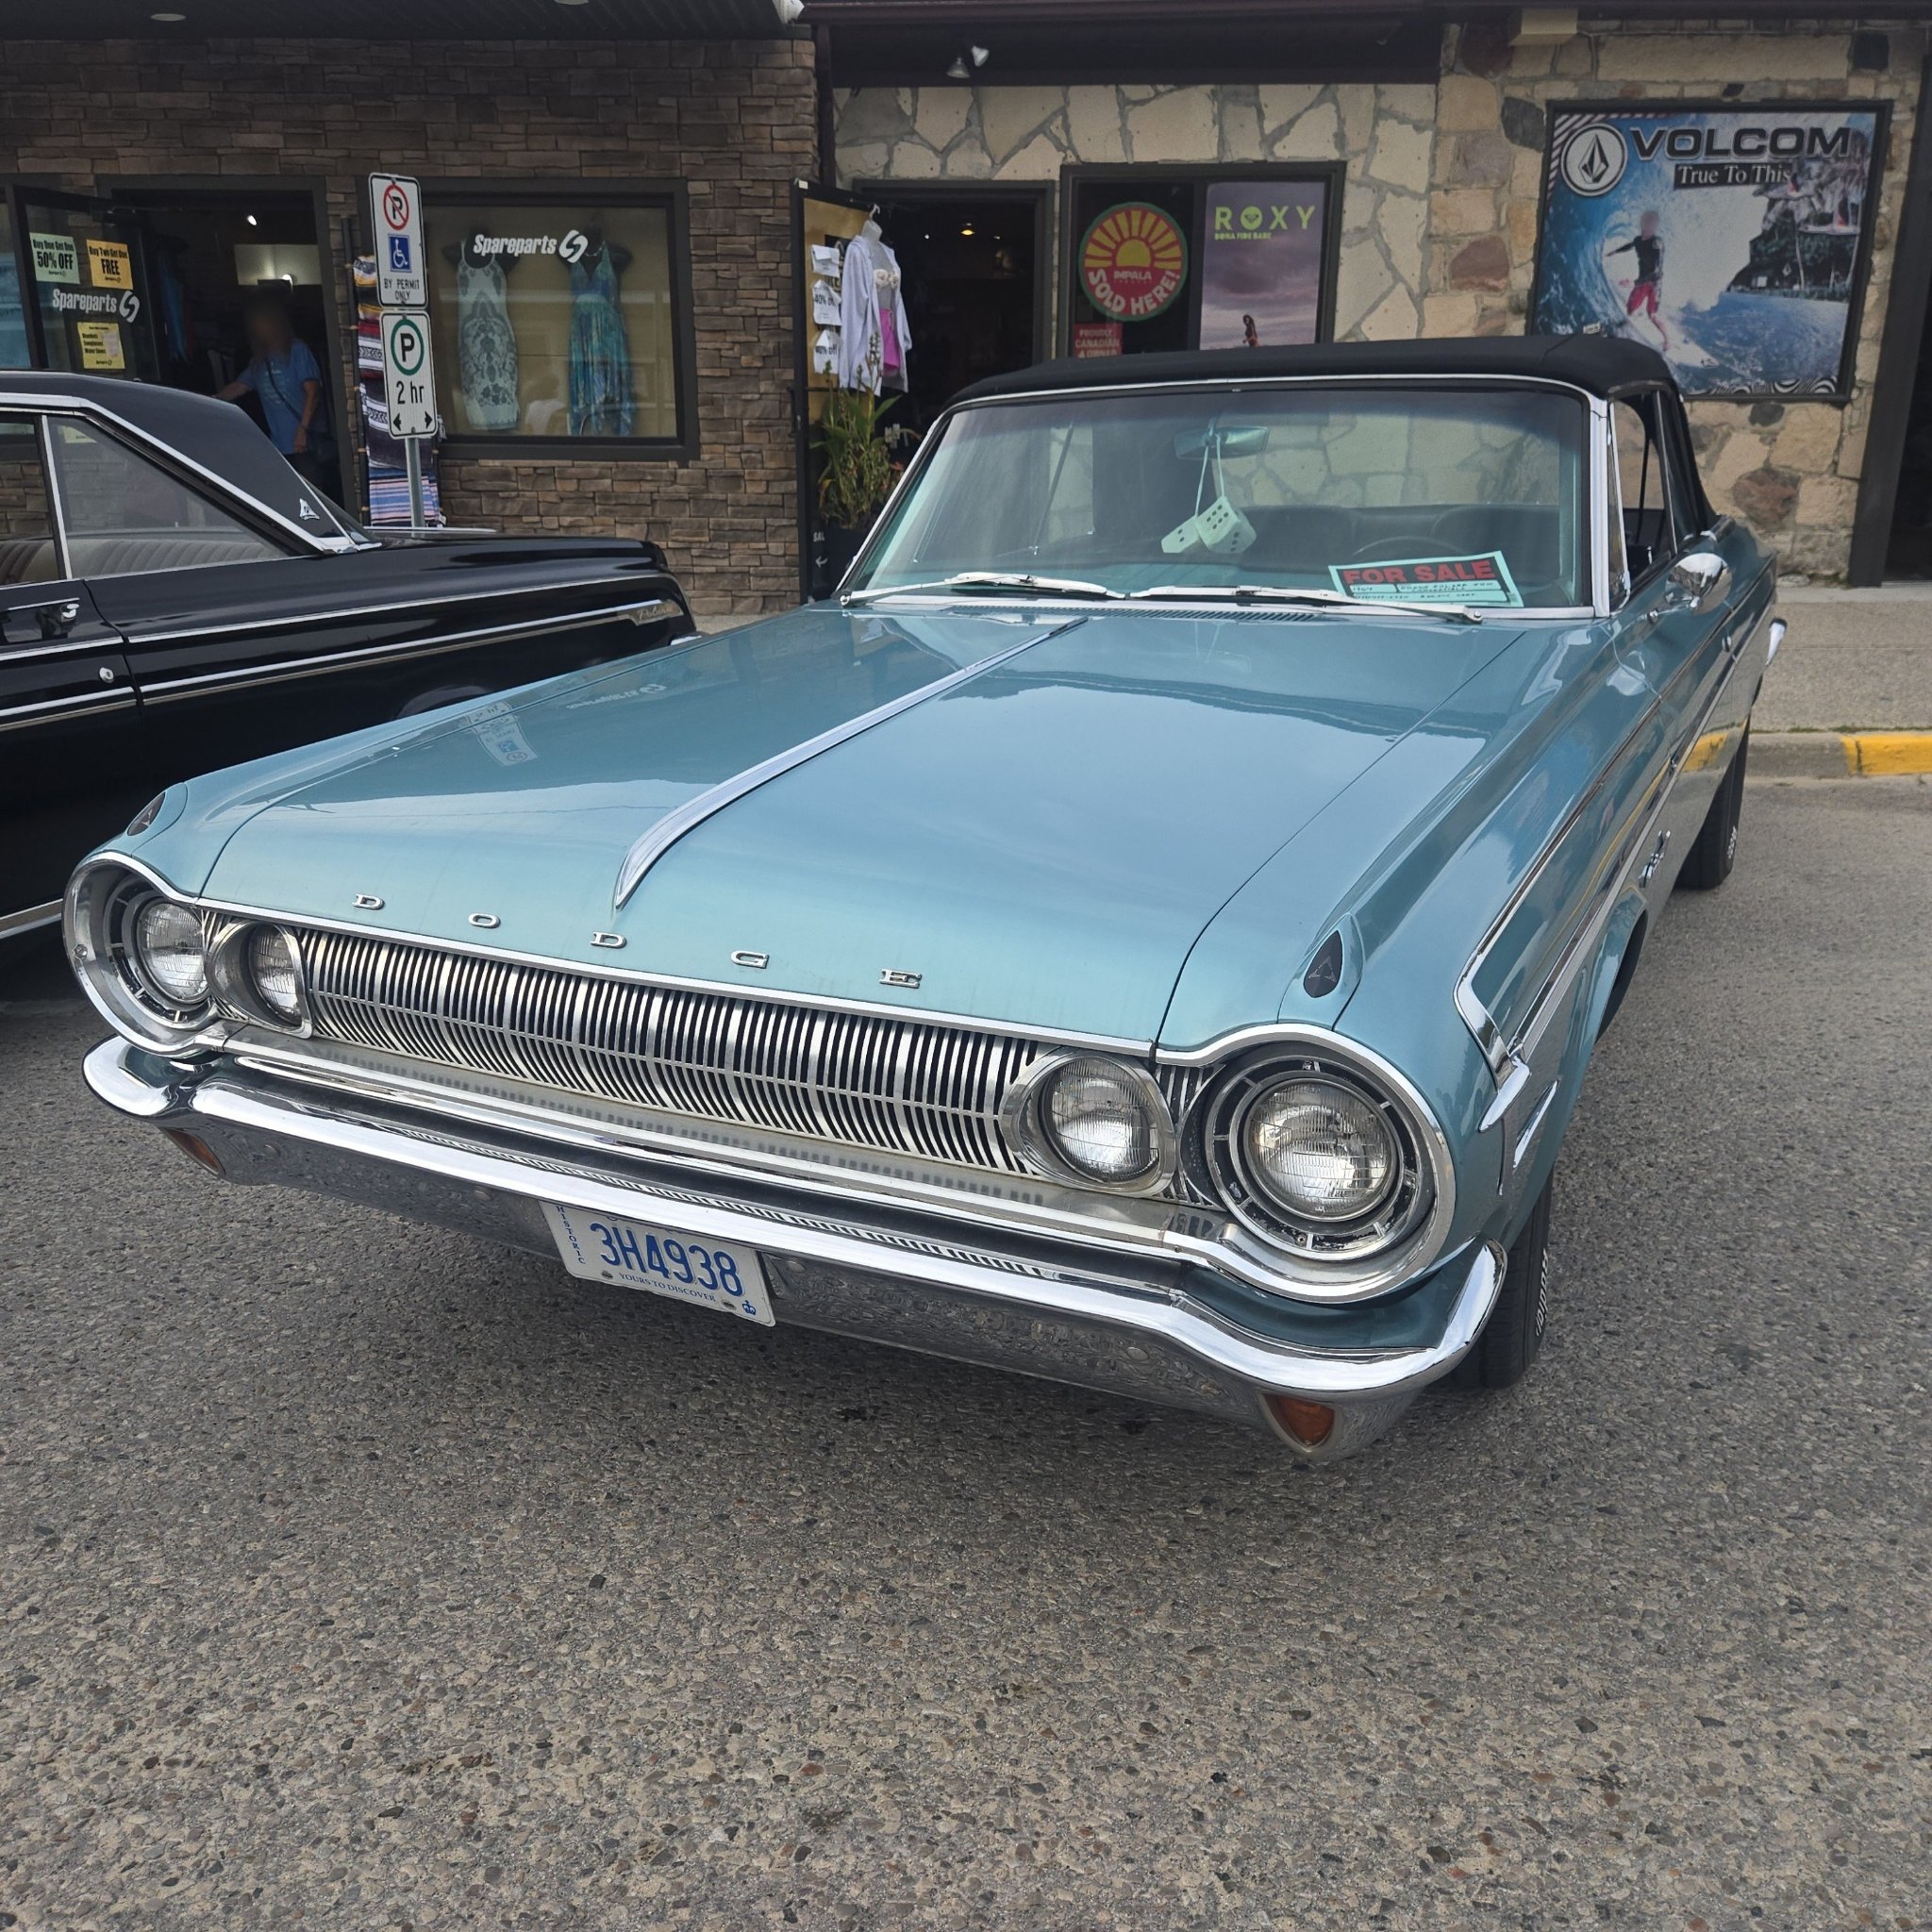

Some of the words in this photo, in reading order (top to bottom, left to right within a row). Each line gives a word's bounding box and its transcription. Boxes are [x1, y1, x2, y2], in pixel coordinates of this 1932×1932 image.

[1629, 126, 1852, 161] VOLCOM
[1677, 166, 1719, 184] True
[1724, 165, 1747, 184] To
[1751, 164, 1791, 183] This
[1214, 205, 1315, 231] ROXY
[473, 234, 558, 257] Spareparts
[37, 251, 57, 269] 50%
[58, 253, 73, 270] OFF
[101, 258, 120, 275] FREE
[384, 278, 392, 290] BY
[396, 278, 420, 291] PERMIT
[1113, 270, 1152, 280] IMPALA
[52, 289, 117, 314] Spareparts
[395, 290, 411, 301] ONLY
[1088, 268, 1126, 313] SOLD
[1130, 270, 1181, 315] HERE!
[400, 332, 415, 362] P
[1074, 339, 1120, 348] CANADIAN
[396, 380, 406, 405] 2
[410, 380, 425, 404] hr
[1342, 567, 1407, 585] FOR
[1414, 559, 1496, 581] SALE
[352, 892, 923, 990] DODGE
[556, 1206, 586, 1265] HISTORIC
[590, 1223, 743, 1297] 3H4938
[619, 1273, 651, 1286] YOURS
[651, 1280, 666, 1290] TO
[667, 1283, 716, 1302] DISCOVER
